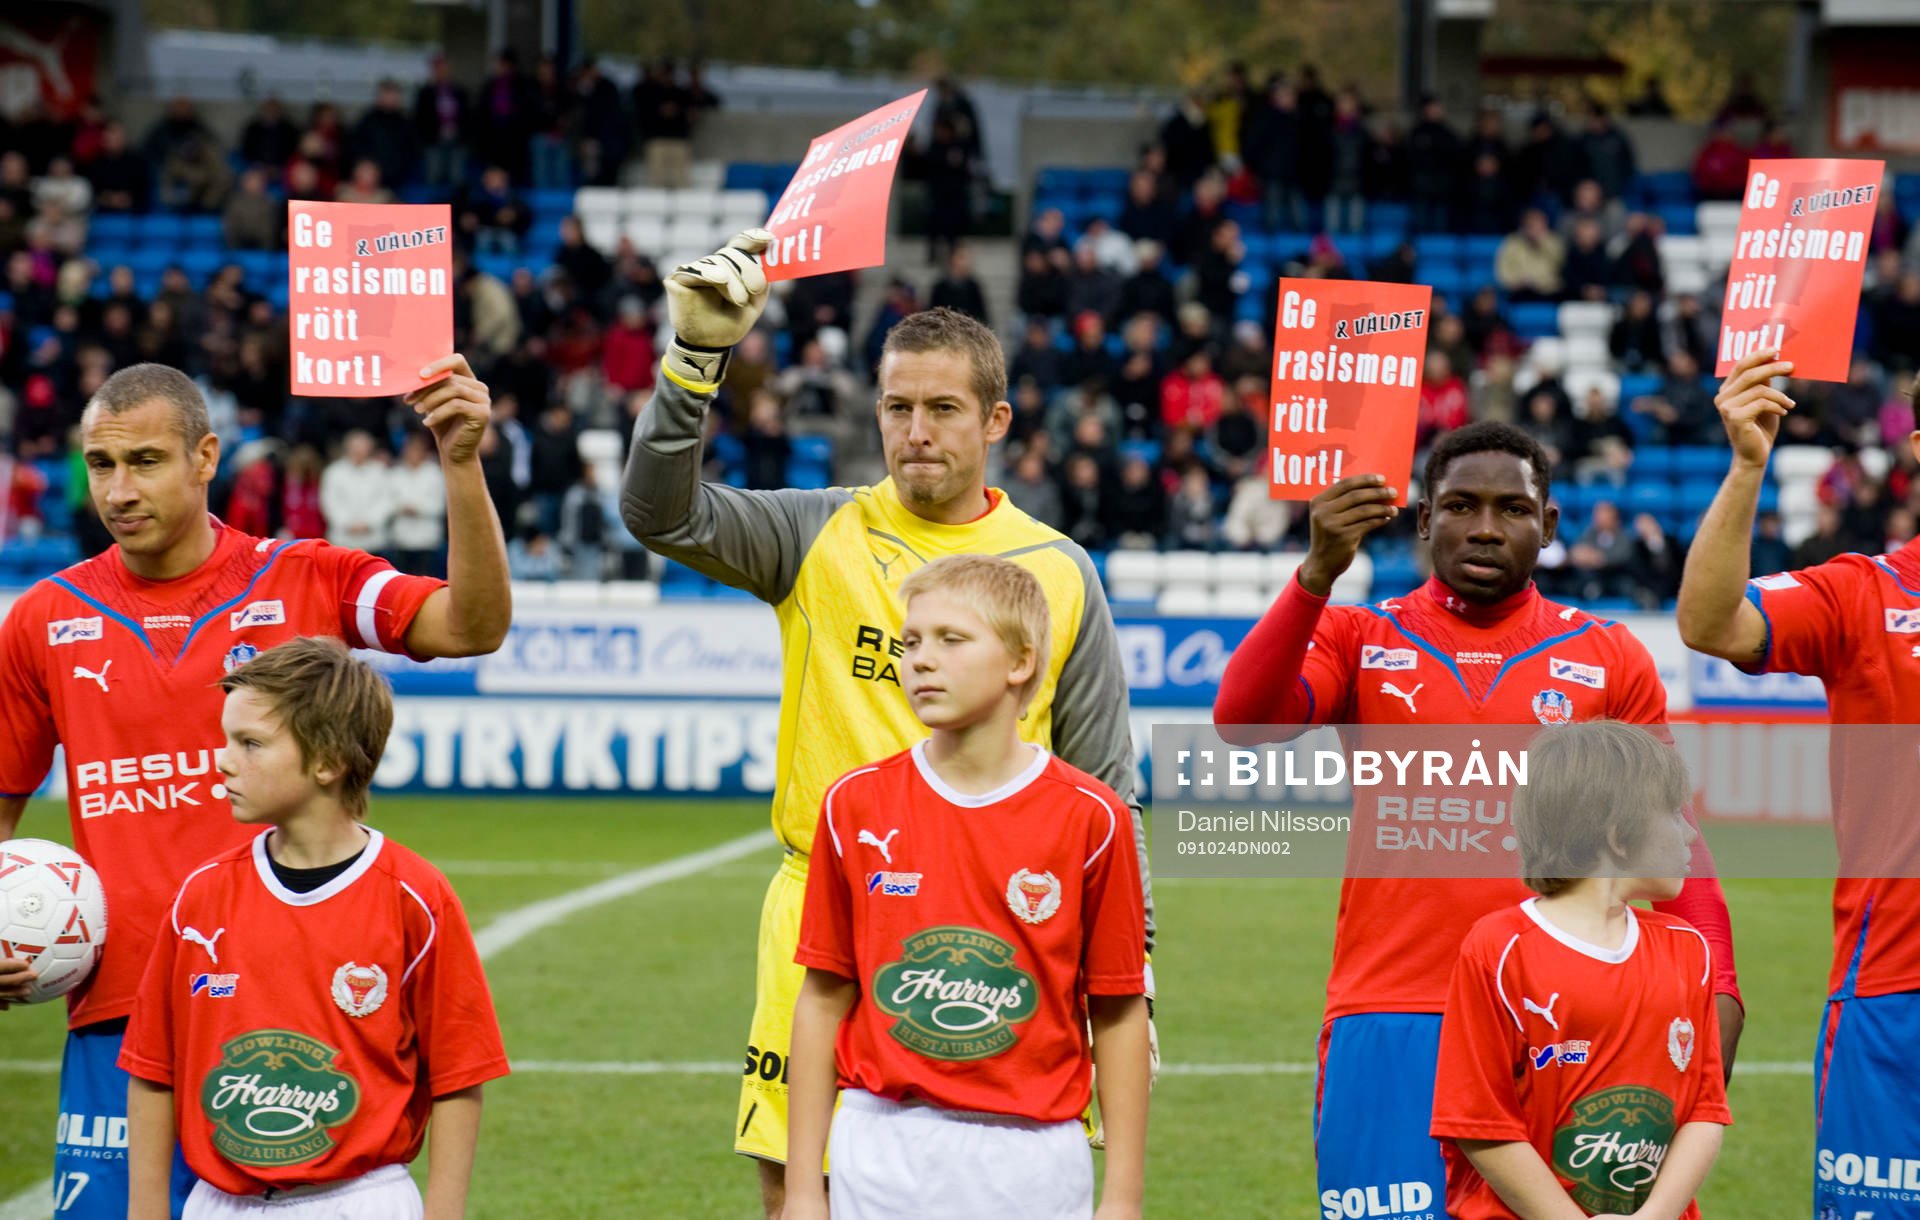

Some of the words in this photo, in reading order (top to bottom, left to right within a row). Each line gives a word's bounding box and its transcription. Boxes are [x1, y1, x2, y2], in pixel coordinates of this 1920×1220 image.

[1747, 172, 1780, 209] Ge
[294, 212, 333, 248] Ge
[765, 225, 823, 267] ort!
[1737, 222, 1865, 262] rasismen
[356, 240, 373, 257] &
[296, 261, 446, 296] rasismen
[1728, 273, 1777, 310] rött
[296, 307, 358, 341] rött
[1282, 290, 1317, 329] Ge
[1336, 320, 1351, 338] &
[297, 351, 382, 387] kort!
[1277, 345, 1418, 388] rasismen
[1274, 394, 1328, 433] rött
[1272, 446, 1344, 486] kort!
[79, 781, 202, 820] BANK
[1377, 796, 1514, 826] RESU
[1376, 825, 1492, 853] BANK
[911, 933, 1007, 957] BOWLING
[892, 968, 1022, 1031] Harrys
[231, 1036, 327, 1061] BOWLING
[898, 1025, 1009, 1054] RESTAURANG
[212, 1073, 340, 1137] Harrys
[215, 1131, 325, 1159] RESTAURANG
[1321, 1181, 1433, 1220] SOLID
